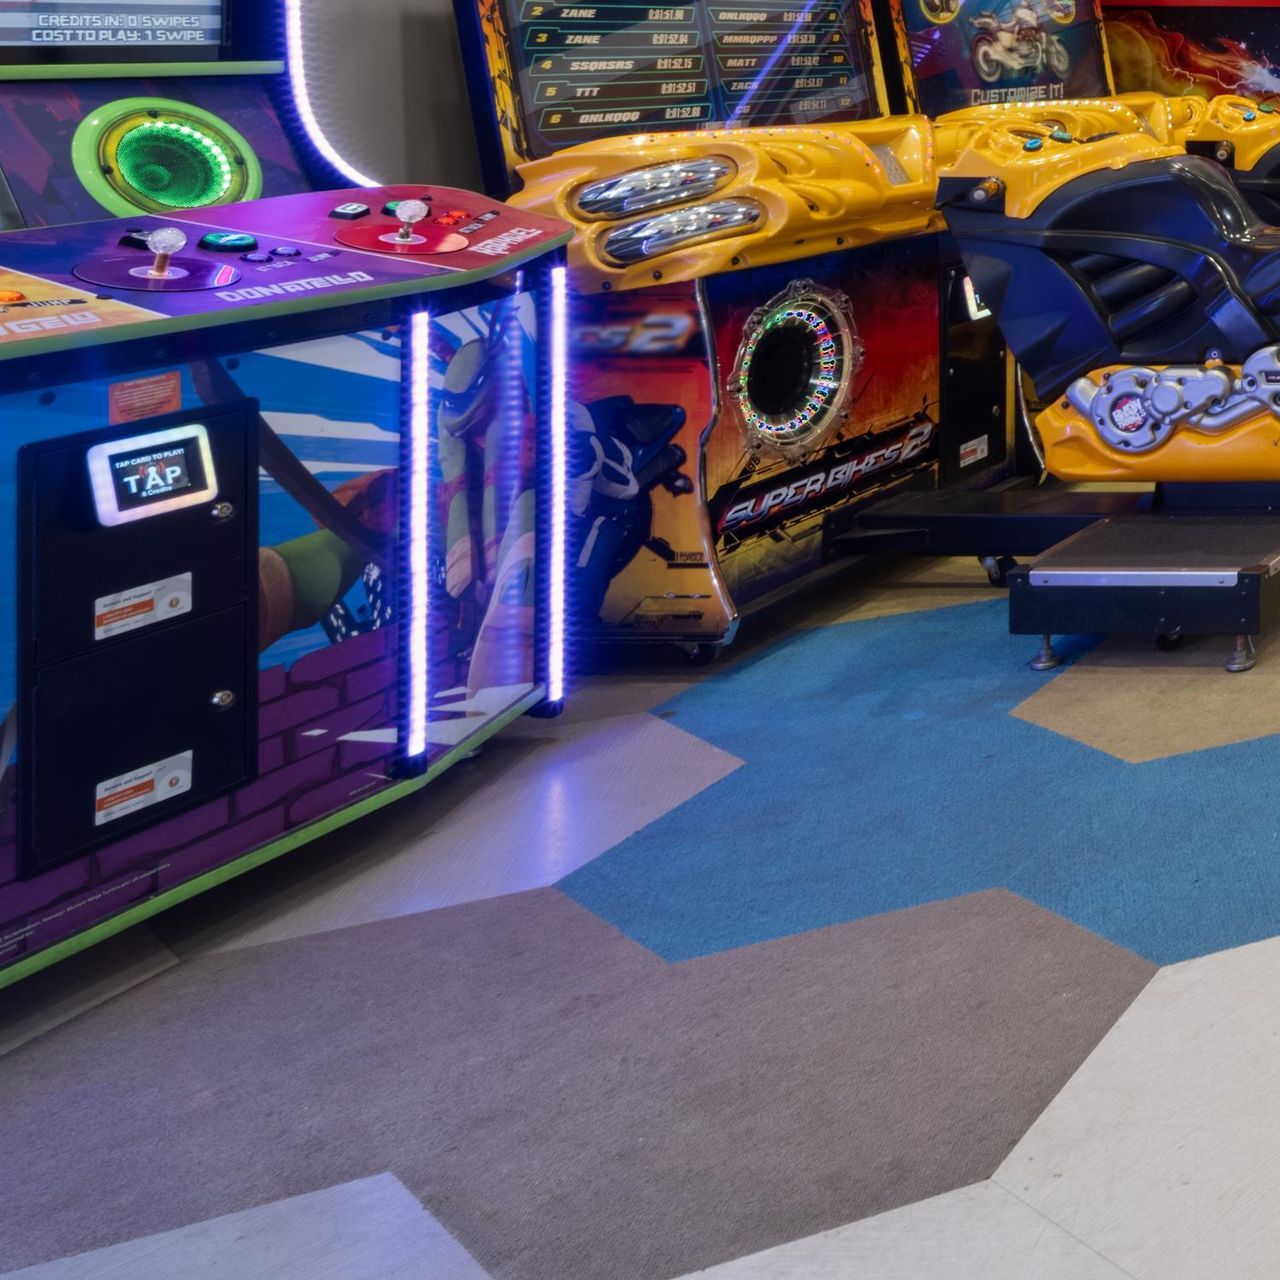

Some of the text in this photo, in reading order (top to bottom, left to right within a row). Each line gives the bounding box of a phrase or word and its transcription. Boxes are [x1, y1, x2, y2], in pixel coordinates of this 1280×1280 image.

[532, 6, 597, 18] 2 ZANE
[39, 15, 102, 27] CREDITS
[105, 15, 124, 27] IN:
[143, 15, 199, 27] SWIPES
[32, 30, 205, 42] COST TO PLAY: 1 SWIPE
[536, 33, 548, 43] 3
[565, 35, 601, 44] ZANE
[541, 59, 552, 69] 4
[545, 87, 557, 96] 5
[576, 87, 600, 97] TTT
[971, 83, 1064, 106] CUSTOMIZE IT!
[550, 114, 561, 123] 6
[902, 422, 934, 460] 2
[115, 448, 184, 469] TAP CARD TO PLAY!
[123, 466, 181, 494] TAP
